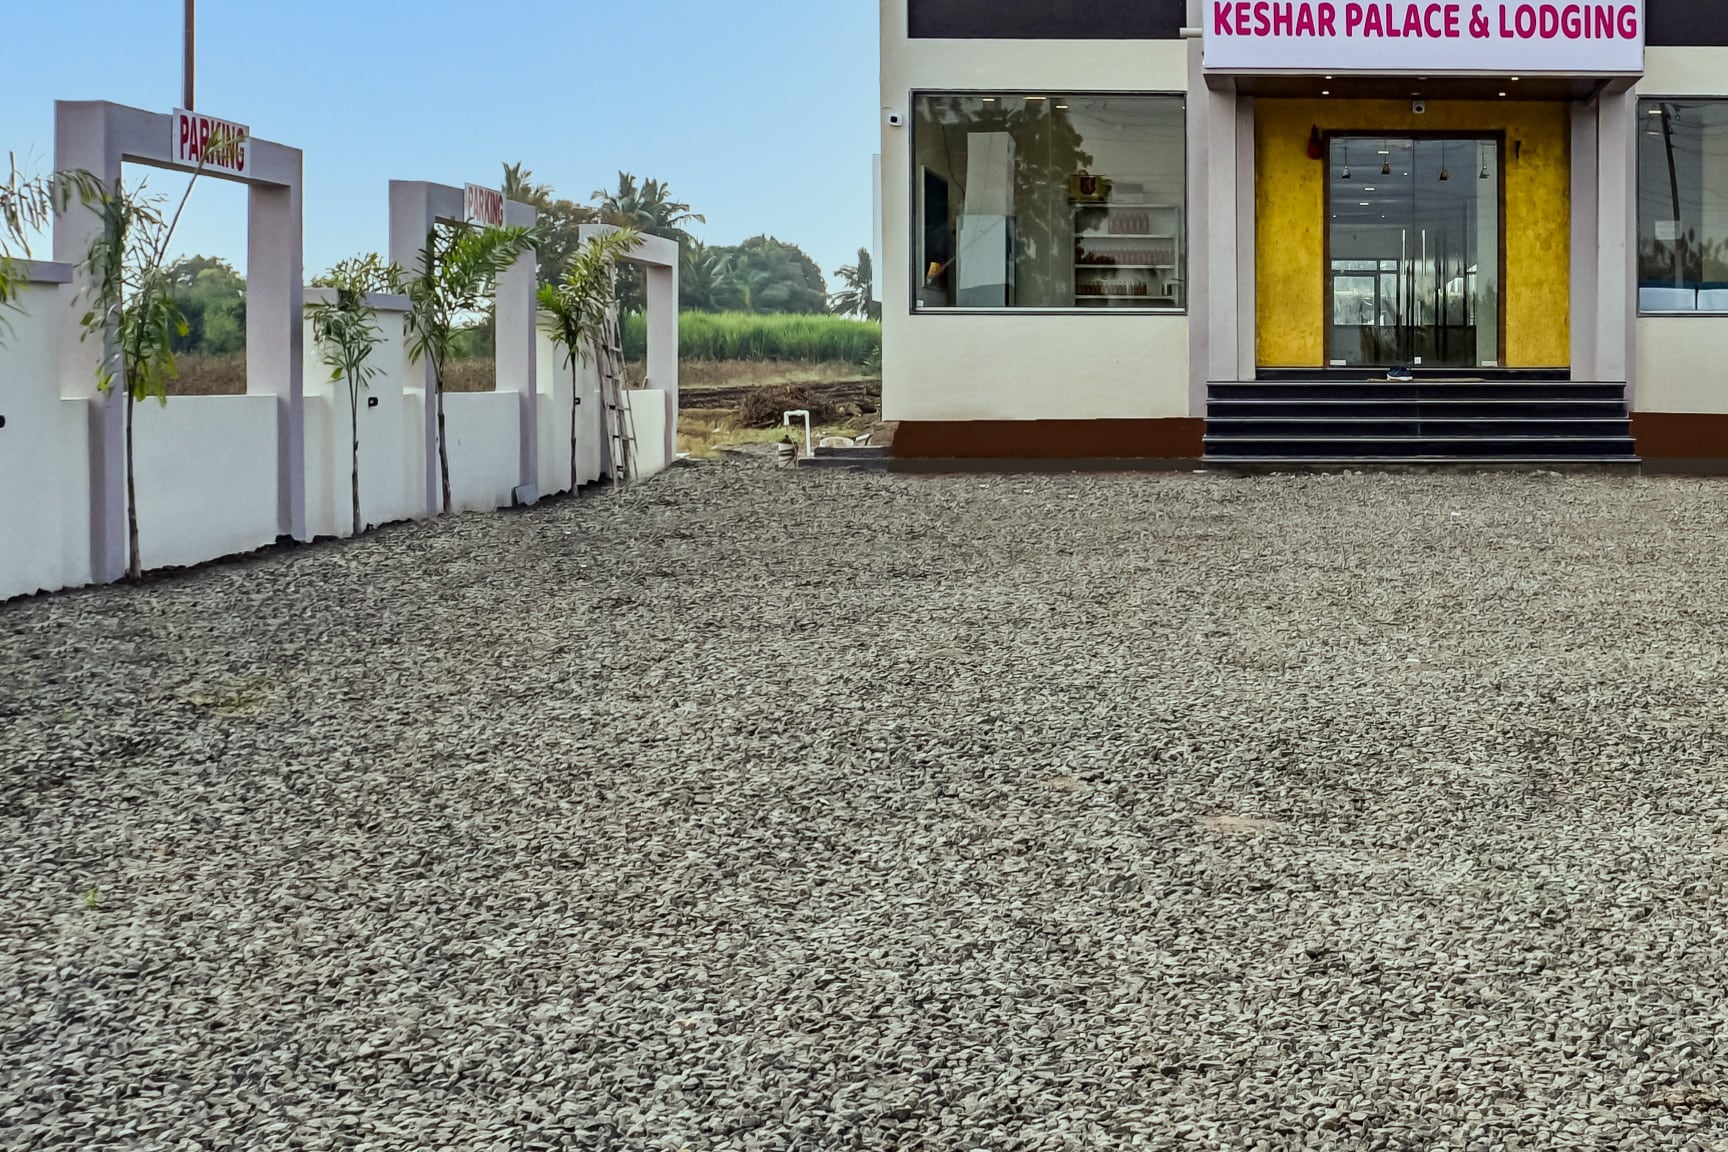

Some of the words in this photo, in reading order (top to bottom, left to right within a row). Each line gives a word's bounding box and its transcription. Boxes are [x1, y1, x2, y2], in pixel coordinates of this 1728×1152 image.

[1213, 1, 1338, 38] KESHAR
[1345, 2, 1460, 39] PALACE
[1468, 4, 1490, 39] &
[1499, 4, 1638, 40] LODGING
[468, 186, 503, 227] PARKING
